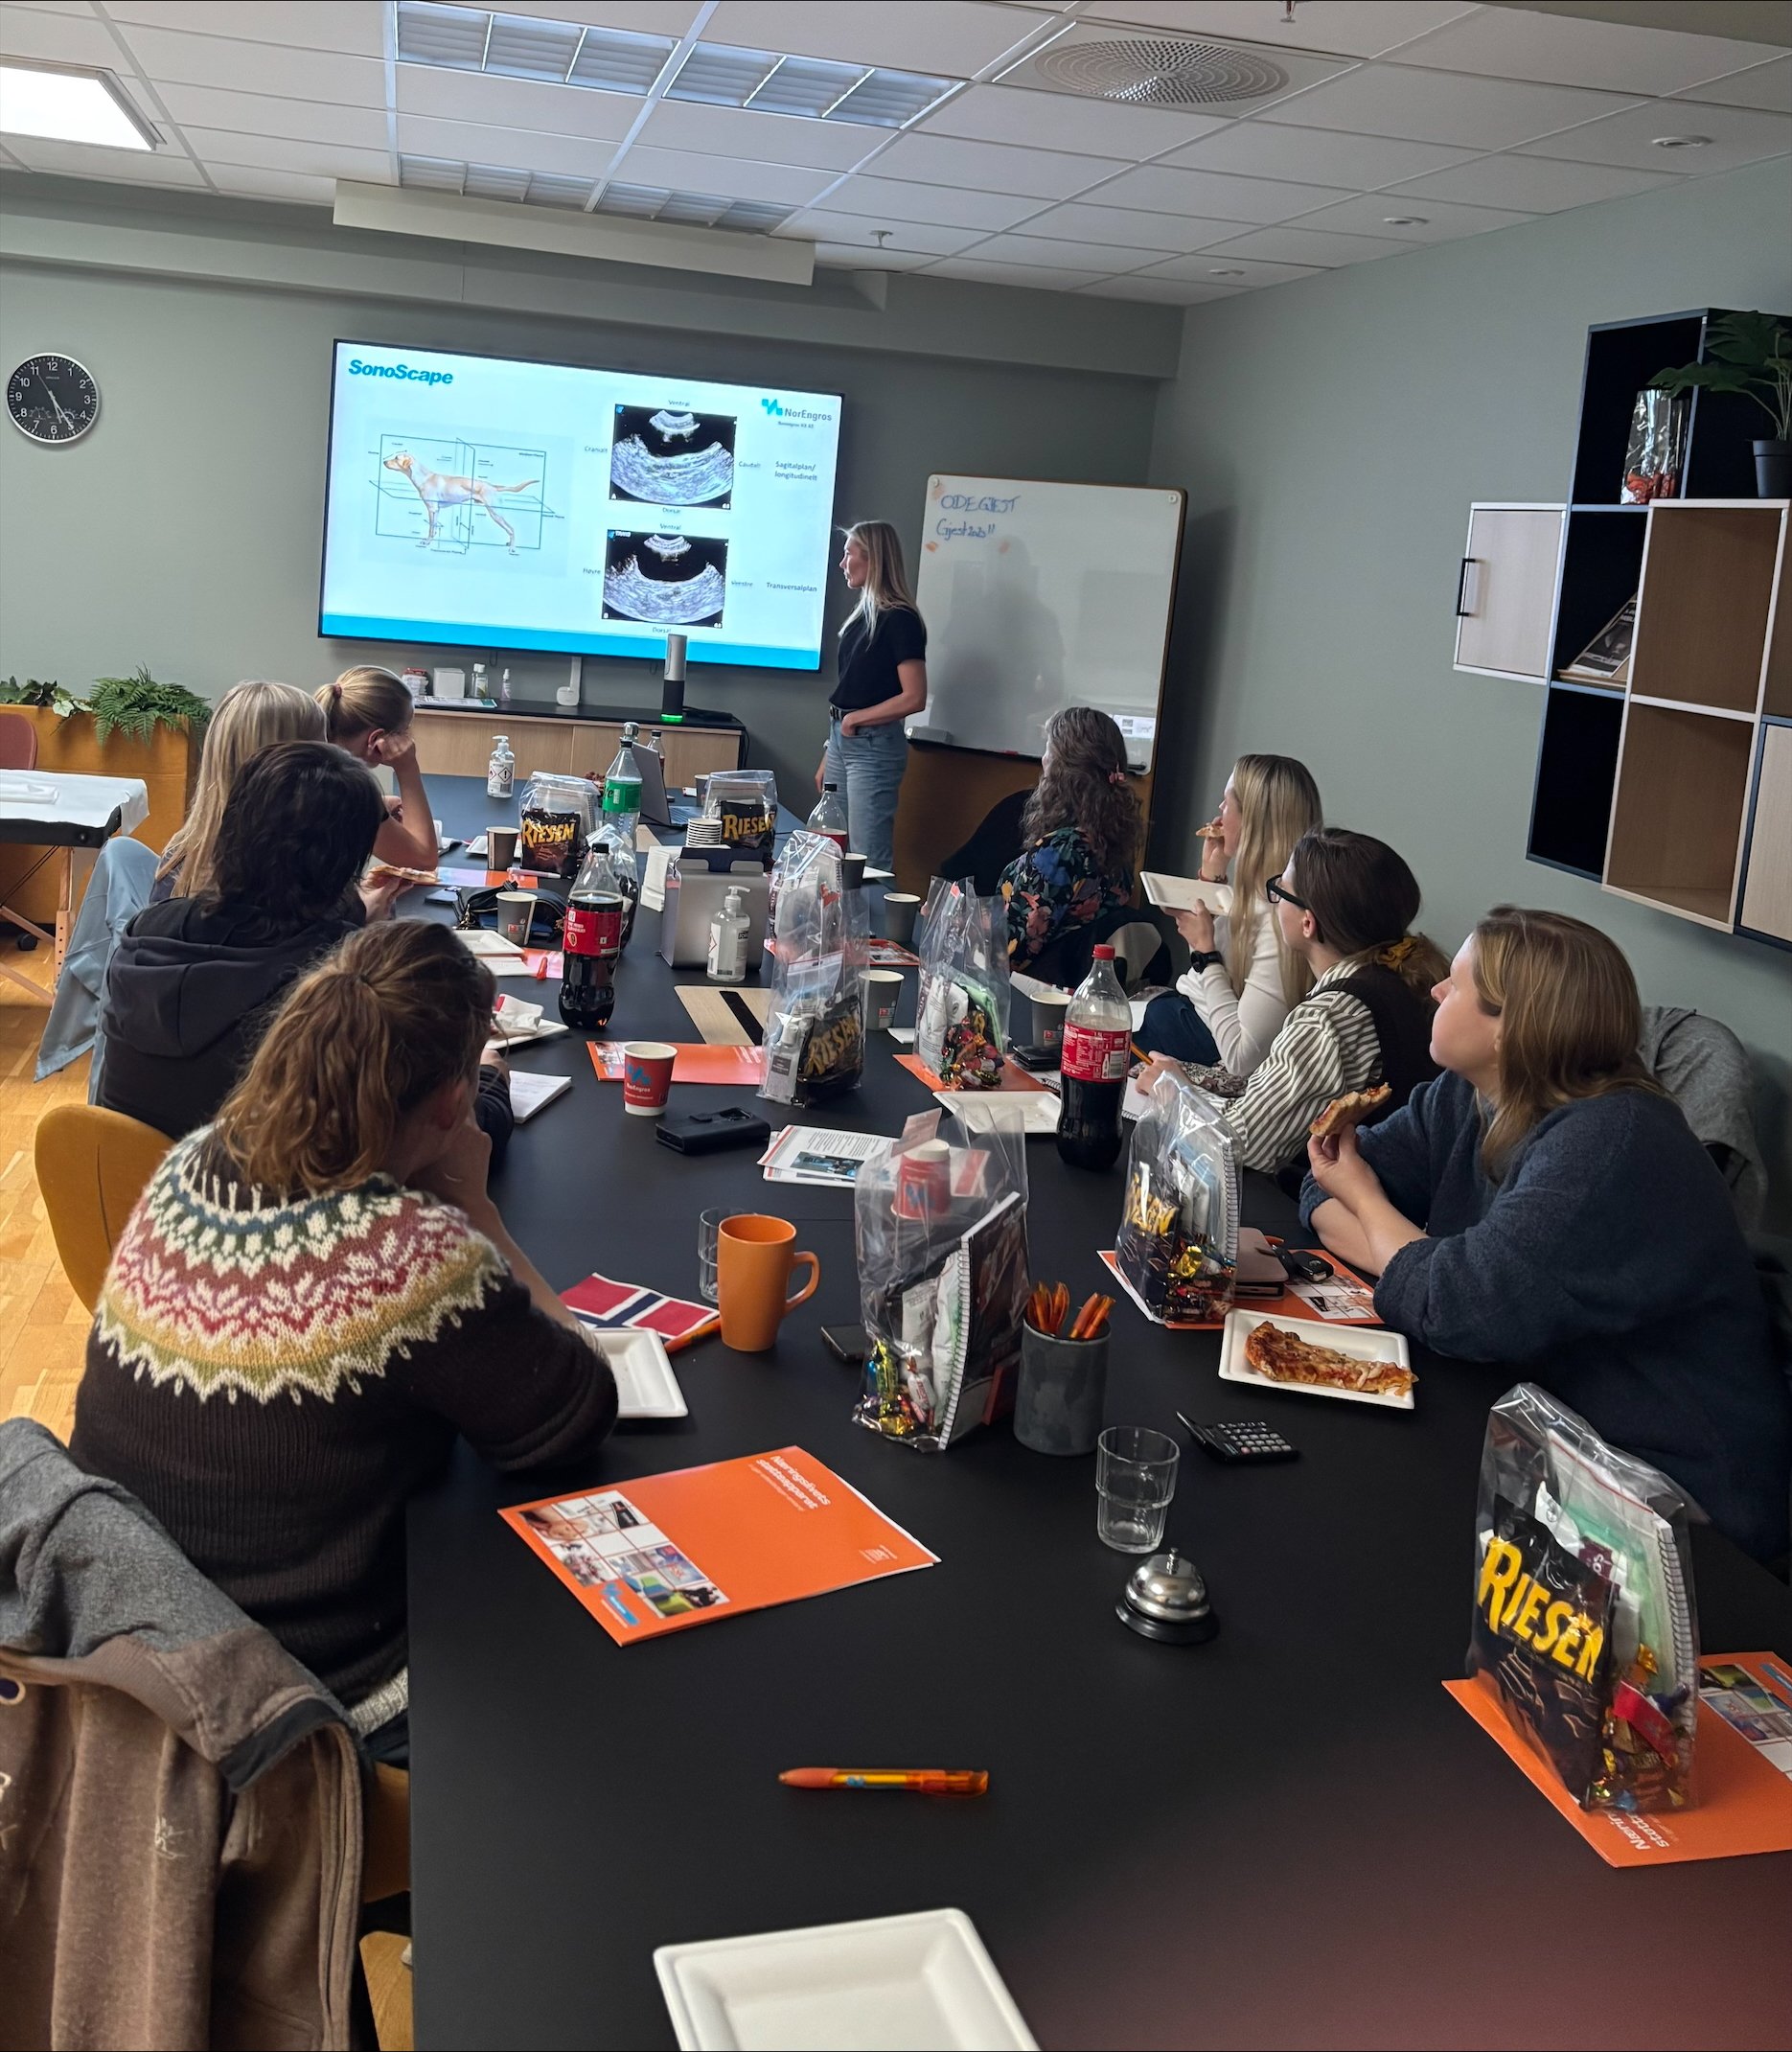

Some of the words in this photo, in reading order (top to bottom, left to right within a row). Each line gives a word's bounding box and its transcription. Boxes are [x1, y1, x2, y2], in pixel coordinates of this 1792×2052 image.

[31, 366, 39, 375] 11
[47, 361, 57, 371] 12
[348, 359, 453, 385] SonoScape
[19, 378, 30, 387] 10
[80, 380, 86, 389] 2
[15, 392, 22, 401] 9
[83, 395, 91, 404] 3
[20, 407, 27, 417] 8
[80, 410, 86, 419] 4
[785, 408, 833, 422] NorEngros
[33, 420, 40, 429] 7
[50, 425, 57, 434] 6
[775, 461, 816, 472] Sagitalplan/
[767, 582, 817, 592] Transversalplan
[723, 814, 775, 840] RIESEN
[521, 818, 575, 849] RIESEN
[1477, 1535, 1604, 1685] RIESEN
[1603, 1810, 1651, 1851] Nærin
[1625, 1811, 1670, 1848] støtt
